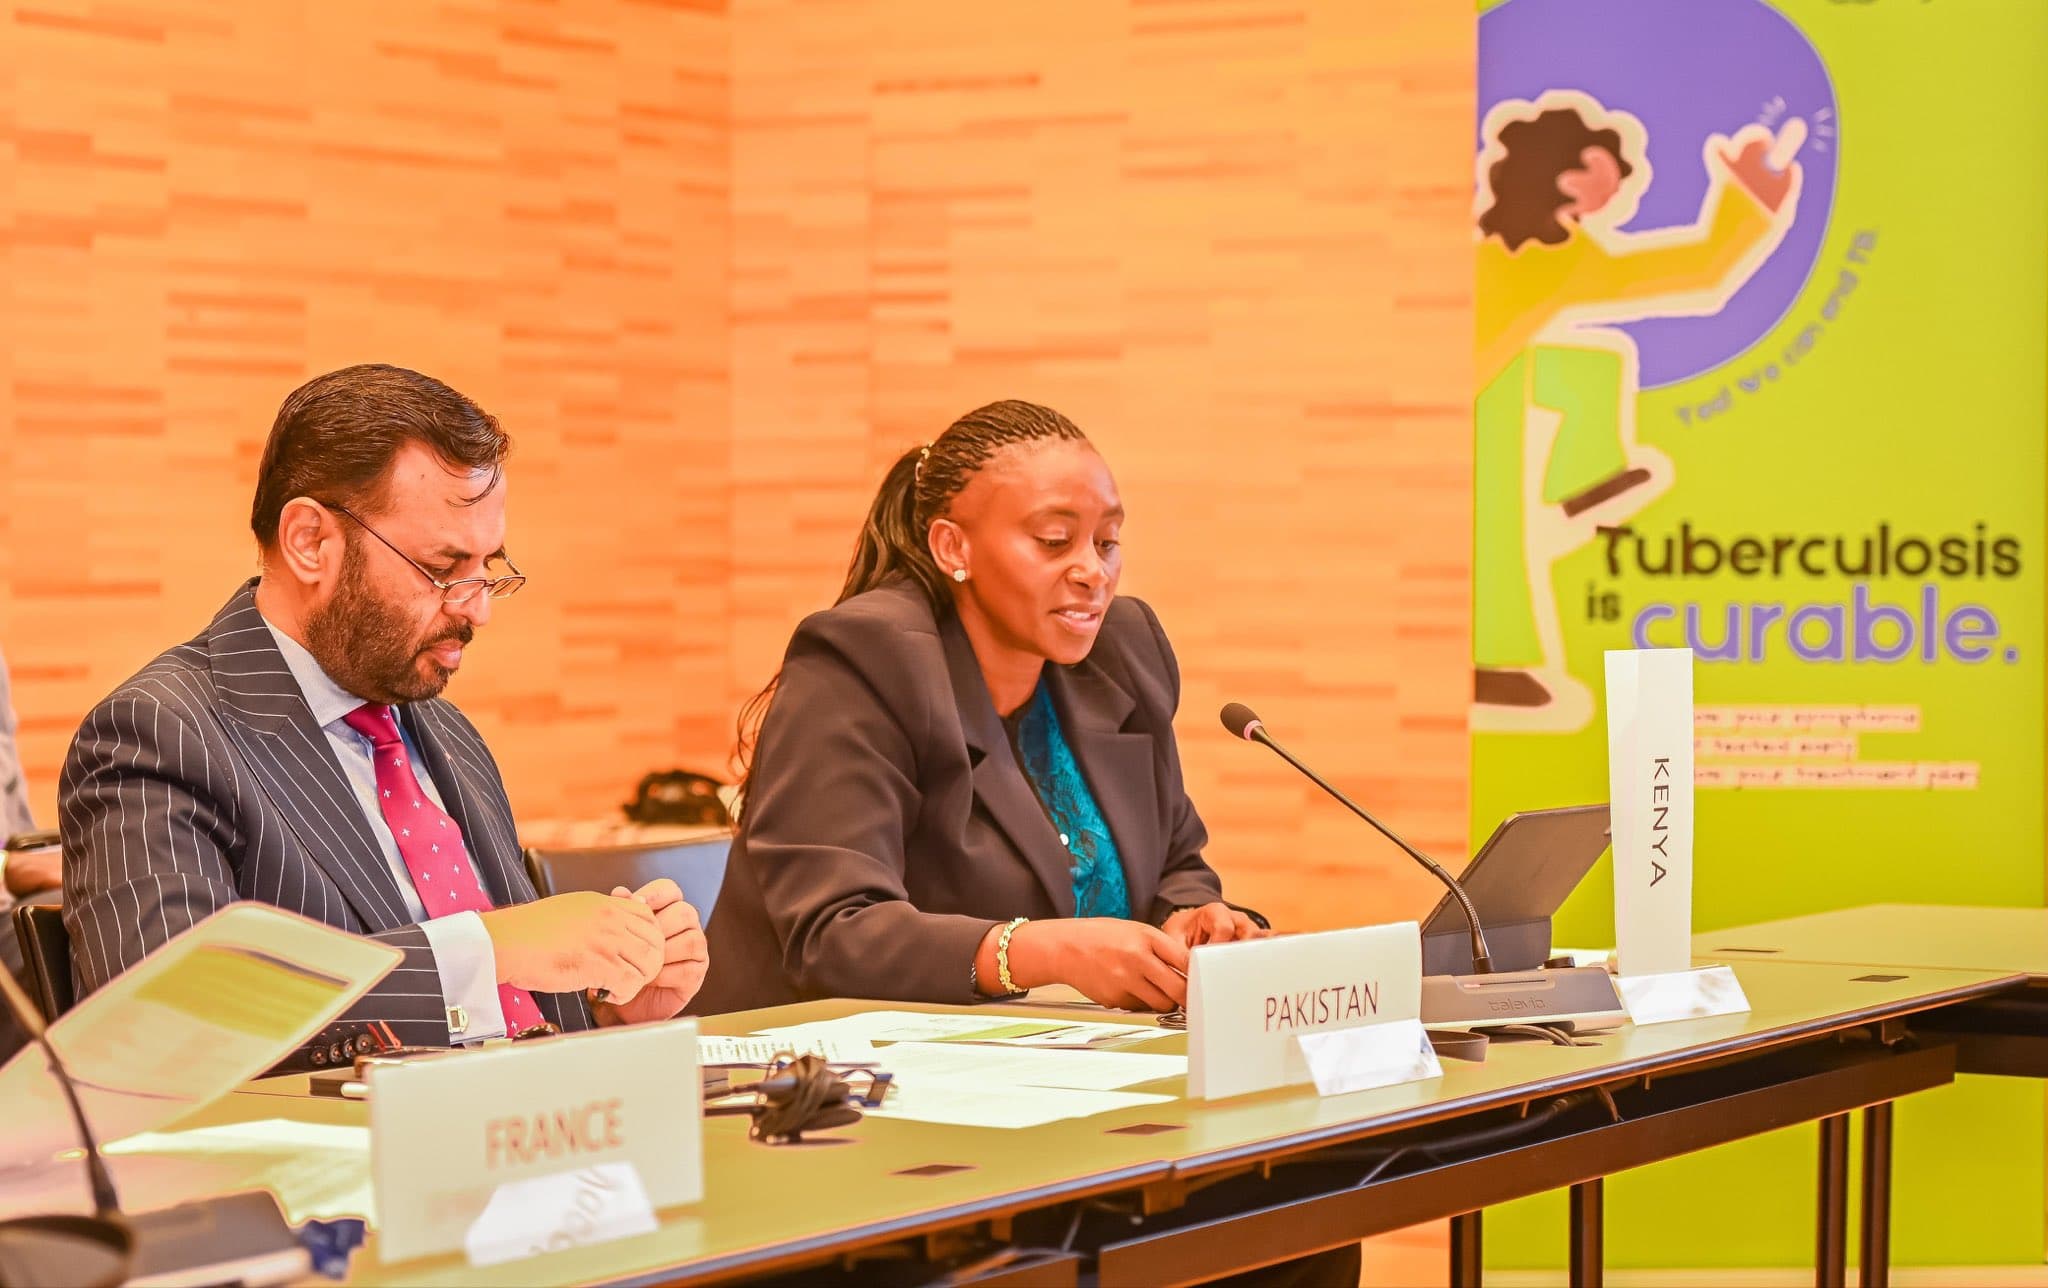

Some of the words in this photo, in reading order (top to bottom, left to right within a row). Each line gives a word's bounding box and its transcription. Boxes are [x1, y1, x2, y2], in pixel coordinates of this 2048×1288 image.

[1595, 522, 2022, 578] Tuberculosis
[1586, 584, 1622, 622] is
[1632, 584, 2020, 663] curable.
[1649, 757, 1670, 887] KENYA
[1263, 981, 1379, 1033] PAKISTAN
[484, 1098, 624, 1169] FRANCE
